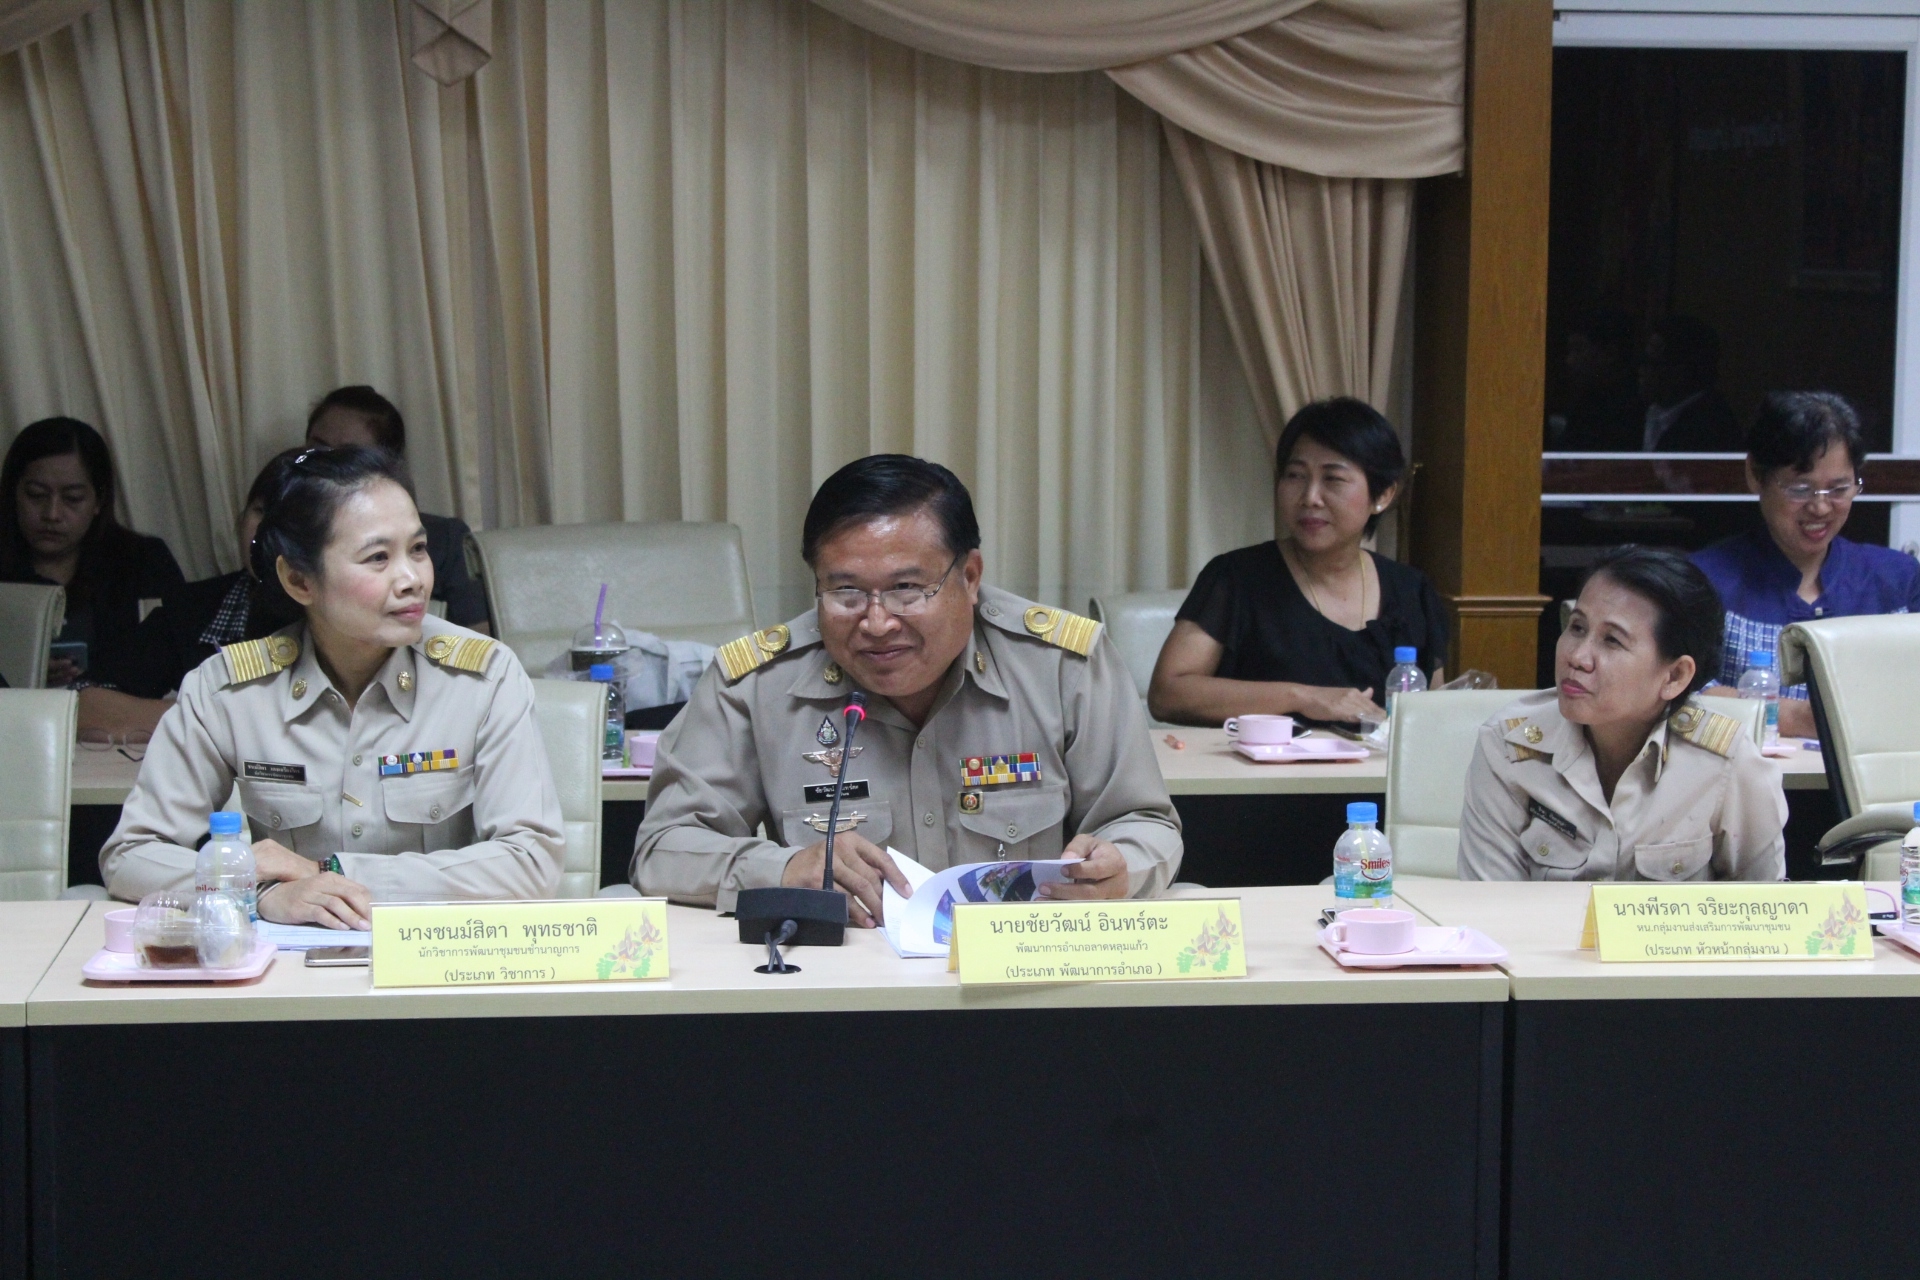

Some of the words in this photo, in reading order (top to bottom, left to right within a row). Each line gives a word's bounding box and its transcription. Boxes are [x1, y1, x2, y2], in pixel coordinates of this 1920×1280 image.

[1360, 857, 1390, 870] Smiles
[1613, 896, 1690, 916] นางพีรดา
[1697, 896, 1809, 922] จริยะกุลญาดา
[398, 918, 508, 941] นางชนม์สิตา
[522, 916, 598, 944] พุทธชาติ
[990, 911, 1091, 933] นายชัยวัฒน์
[1098, 910, 1168, 931] อินทร์ตะ
[1016, 939, 1148, 954] พัฒนาการอำเภอลาดหลุมแก้ว
